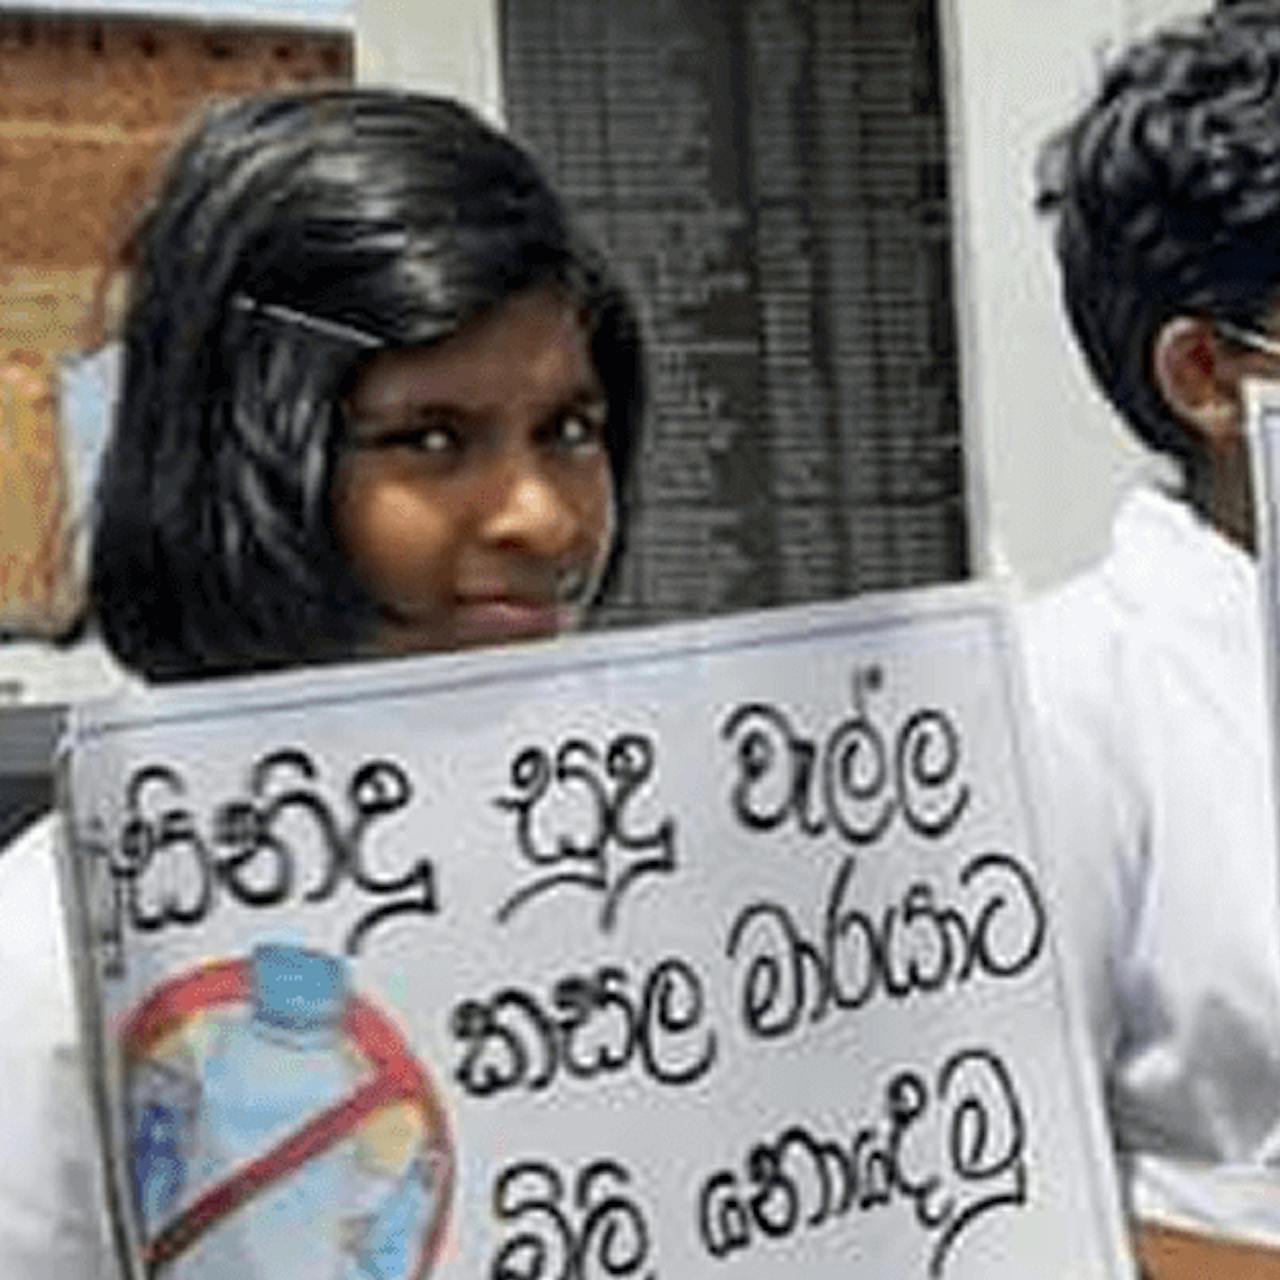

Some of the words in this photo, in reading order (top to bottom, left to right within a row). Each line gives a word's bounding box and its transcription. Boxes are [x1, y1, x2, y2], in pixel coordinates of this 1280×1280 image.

[493, 732, 677, 933] සුදු
[720, 662, 972, 847] වැල්ල
[452, 957, 719, 1097] කසල
[725, 853, 1047, 1039] මාරයාට
